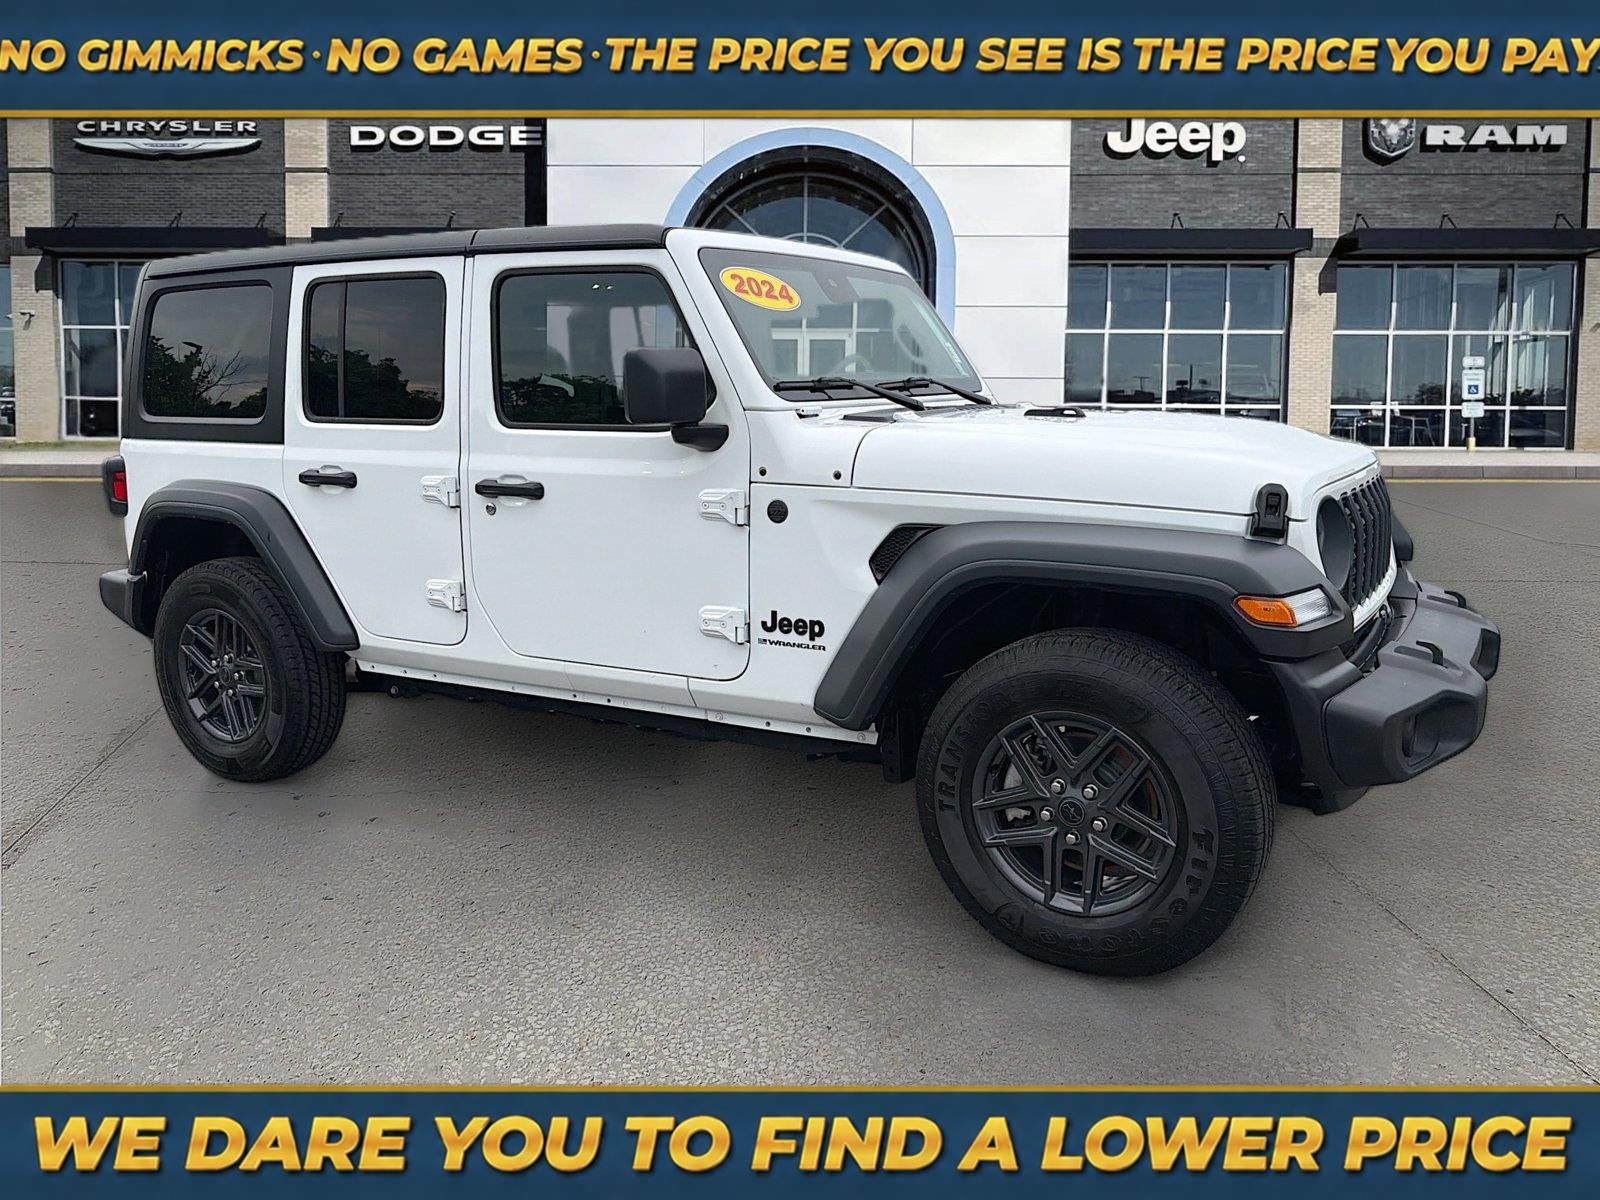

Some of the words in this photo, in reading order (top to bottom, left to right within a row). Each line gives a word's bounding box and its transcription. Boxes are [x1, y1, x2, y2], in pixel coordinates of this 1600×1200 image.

[76, 120, 257, 133] CHRYSLER
[350, 125, 544, 149] DODGE
[1424, 124, 1568, 149] RAM
[1106, 118, 1247, 162] Jeep
[730, 273, 794, 304] 2024
[760, 609, 826, 642] Jeep
[767, 638, 827, 652] WRANGLER
